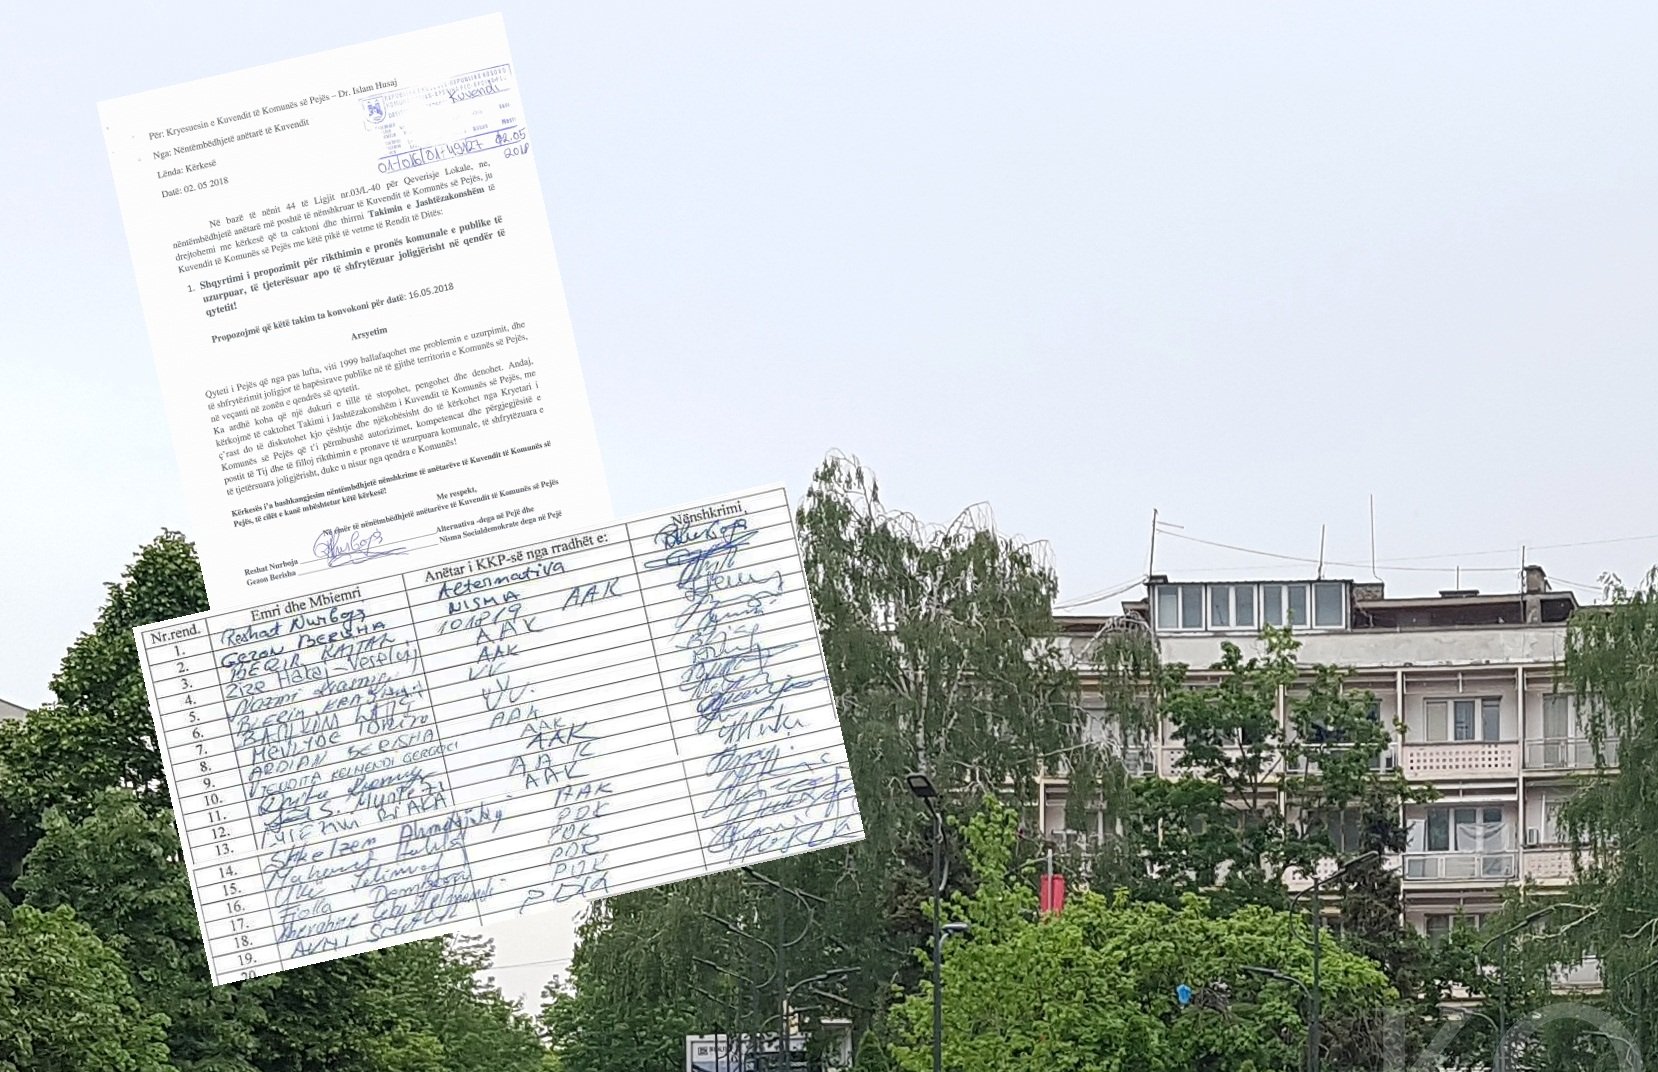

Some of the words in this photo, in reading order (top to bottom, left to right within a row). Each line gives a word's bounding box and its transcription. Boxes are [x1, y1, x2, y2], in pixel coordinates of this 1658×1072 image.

[148, 131, 165, 141] Për:
[165, 120, 210, 137] Kryesuesin
[216, 111, 252, 126] Kuvendit
[261, 101, 299, 116] Komunës
[308, 94, 331, 105] Pejës
[352, 84, 375, 95] Islam
[374, 78, 398, 90] Husaj
[152, 150, 172, 161] Nga:
[236, 128, 264, 142] anëtarë
[273, 118, 310, 133] Kuvendit
[156, 167, 184, 180] Lënda:
[185, 159, 217, 173] Kërkesë
[161, 187, 183, 199] Datë:
[209, 176, 229, 188] 2018
[225, 213, 244, 225] bazë
[261, 205, 281, 217] nënit
[313, 193, 336, 205] Ligjit
[340, 182, 382, 199] nr.03/L-40
[403, 170, 440, 186] Qeverisje
[444, 163, 474, 176] Lokale,
[175, 244, 217, 262] drejtohemi
[234, 235, 265, 248] kërkesë
[291, 222, 320, 236] caktoni
[340, 211, 365, 225] thirrni
[367, 204, 404, 218] Takimin
[199, 272, 245, 290] Shqyrtimi
[253, 260, 301, 280] propozimit
[321, 247, 363, 263] rikthimin
[373, 237, 404, 254] pronës
[405, 227, 449, 244] komunale
[458, 218, 492, 235] publike
[202, 287, 248, 304] uzurpuar,
[262, 273, 310, 292] tjeterësuar
[344, 254, 395, 272] shfrytëzuar
[462, 231, 494, 247] qendër
[205, 300, 238, 318] qytetit!
[211, 325, 261, 344] Propozojmë
[272, 318, 291, 330] këtë
[291, 314, 316, 326] takim
[326, 300, 370, 318] konvokoni
[386, 293, 407, 305] datë:
[408, 281, 455, 300] 16.05.2018
[351, 327, 388, 341] Arsyetim
[434, 519, 476, 535] Alternativa
[476, 515, 496, 524] -dega
[504, 508, 521, 518] Pejë
[670, 500, 743, 529] Nënshkrimi
[438, 534, 462, 544] Nisma
[519, 517, 537, 526] dega
[546, 509, 563, 520] Pejë
[424, 565, 466, 583] Anëtar
[467, 560, 473, 573] i
[475, 550, 524, 571] KKP-së
[525, 547, 549, 561] nga
[550, 535, 595, 554] rradhët
[596, 533, 609, 544] e:
[243, 565, 269, 577] Reshat
[268, 558, 299, 571] Nurboja
[246, 576, 269, 587] Gezon
[269, 570, 297, 582] Berisha
[250, 603, 281, 622] Emri
[284, 600, 307, 614] dhe
[308, 585, 362, 609] Mbiemri
[149, 623, 202, 645] Nr.rend.
[174, 645, 186, 657] 1.
[176, 661, 190, 674] 2.
[180, 677, 193, 690] 3.
[184, 694, 197, 705] 4.
[188, 710, 201, 723] 5.
[192, 727, 204, 739] 6.
[195, 743, 208, 756] 7.
[199, 760, 212, 773] 8.
[202, 777, 216, 789] 9.
[204, 793, 223, 807] 10.
[208, 810, 227, 823] 11.
[211, 826, 231, 840] 12.
[215, 842, 234, 857] 13.
[219, 865, 238, 879] 14.
[223, 882, 242, 897] 15.
[226, 899, 245, 914] 16.
[230, 917, 250, 932] 17.
[234, 935, 253, 949] 18.
[238, 952, 257, 966] 19.
